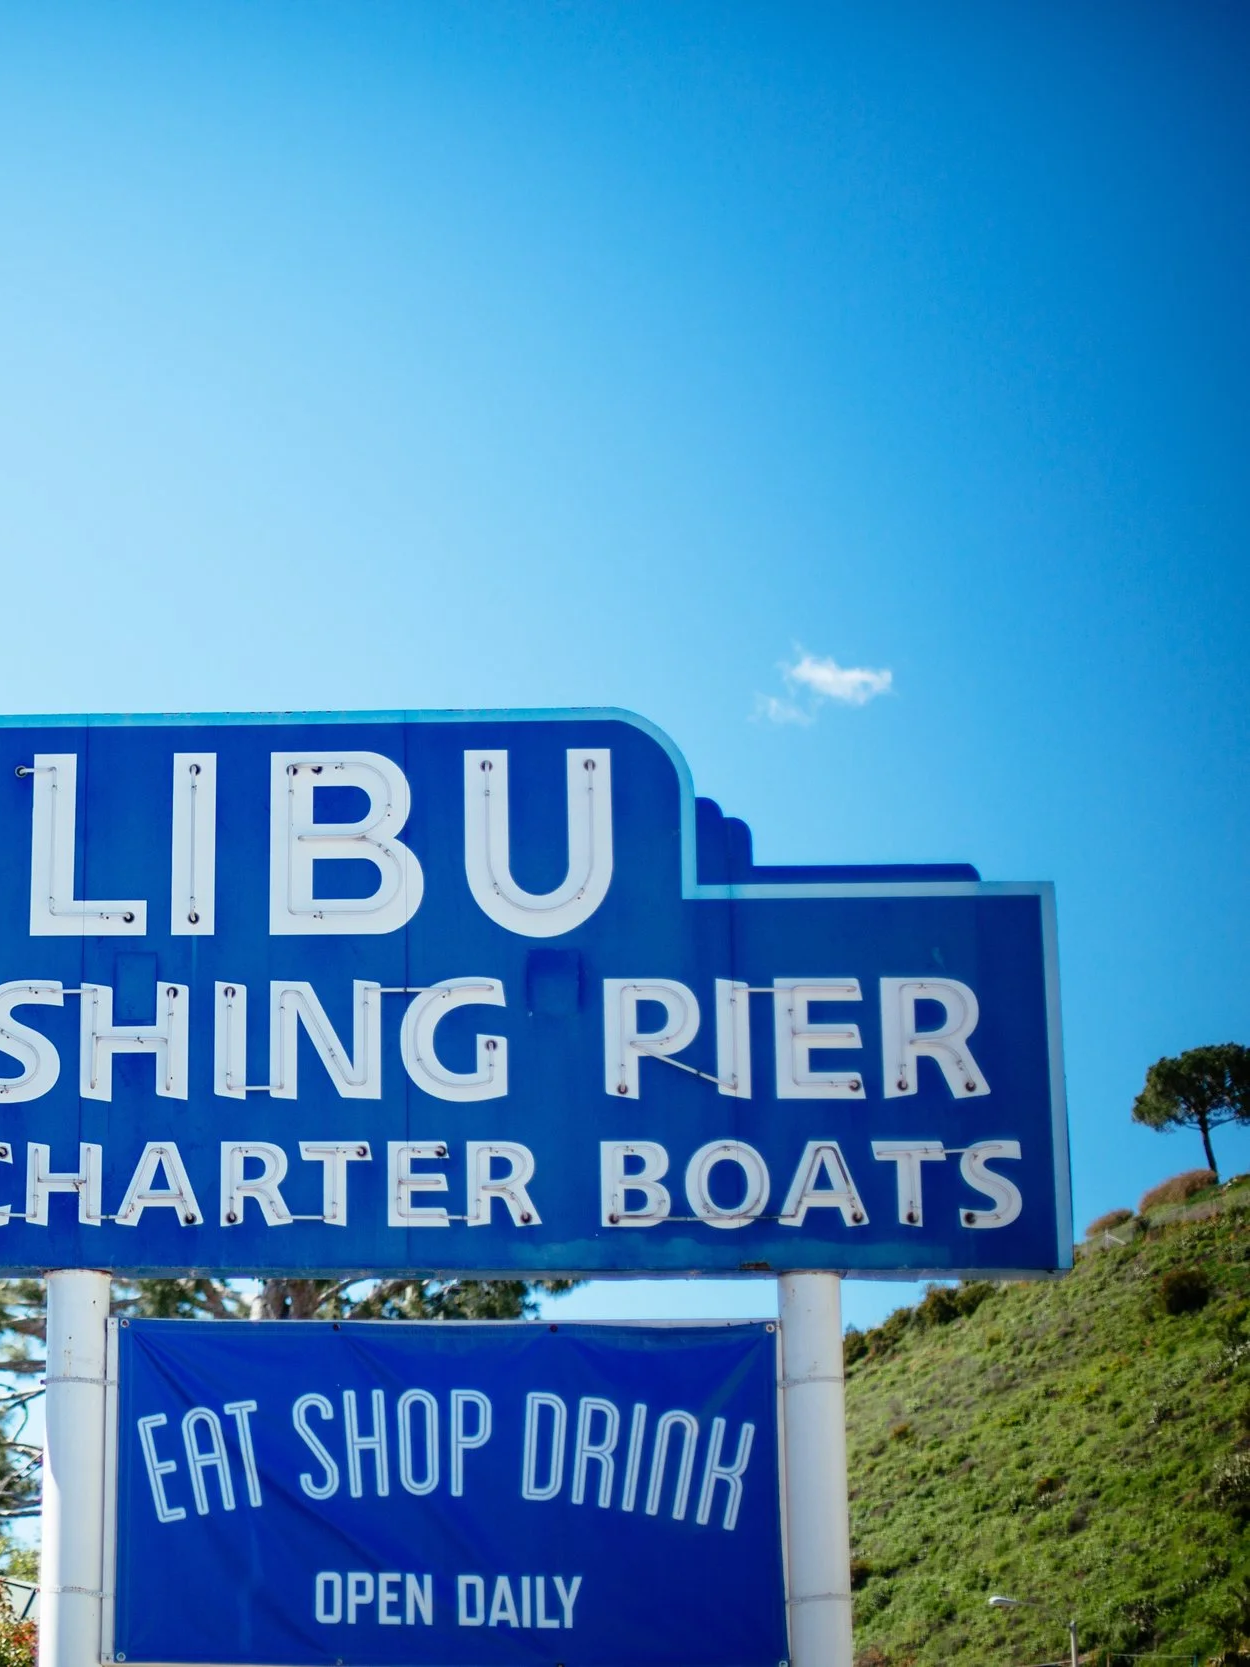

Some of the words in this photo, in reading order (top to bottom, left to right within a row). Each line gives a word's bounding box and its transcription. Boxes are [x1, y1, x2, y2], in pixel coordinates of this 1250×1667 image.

[603, 977, 991, 1100] PIER
[600, 1140, 1023, 1230] BOATS
[137, 1400, 263, 1524] EAT
[292, 1388, 492, 1500] SHOP
[521, 1391, 756, 1531] DRINK
[315, 1571, 433, 1626] OPEN
[457, 1574, 582, 1630] DAILY
